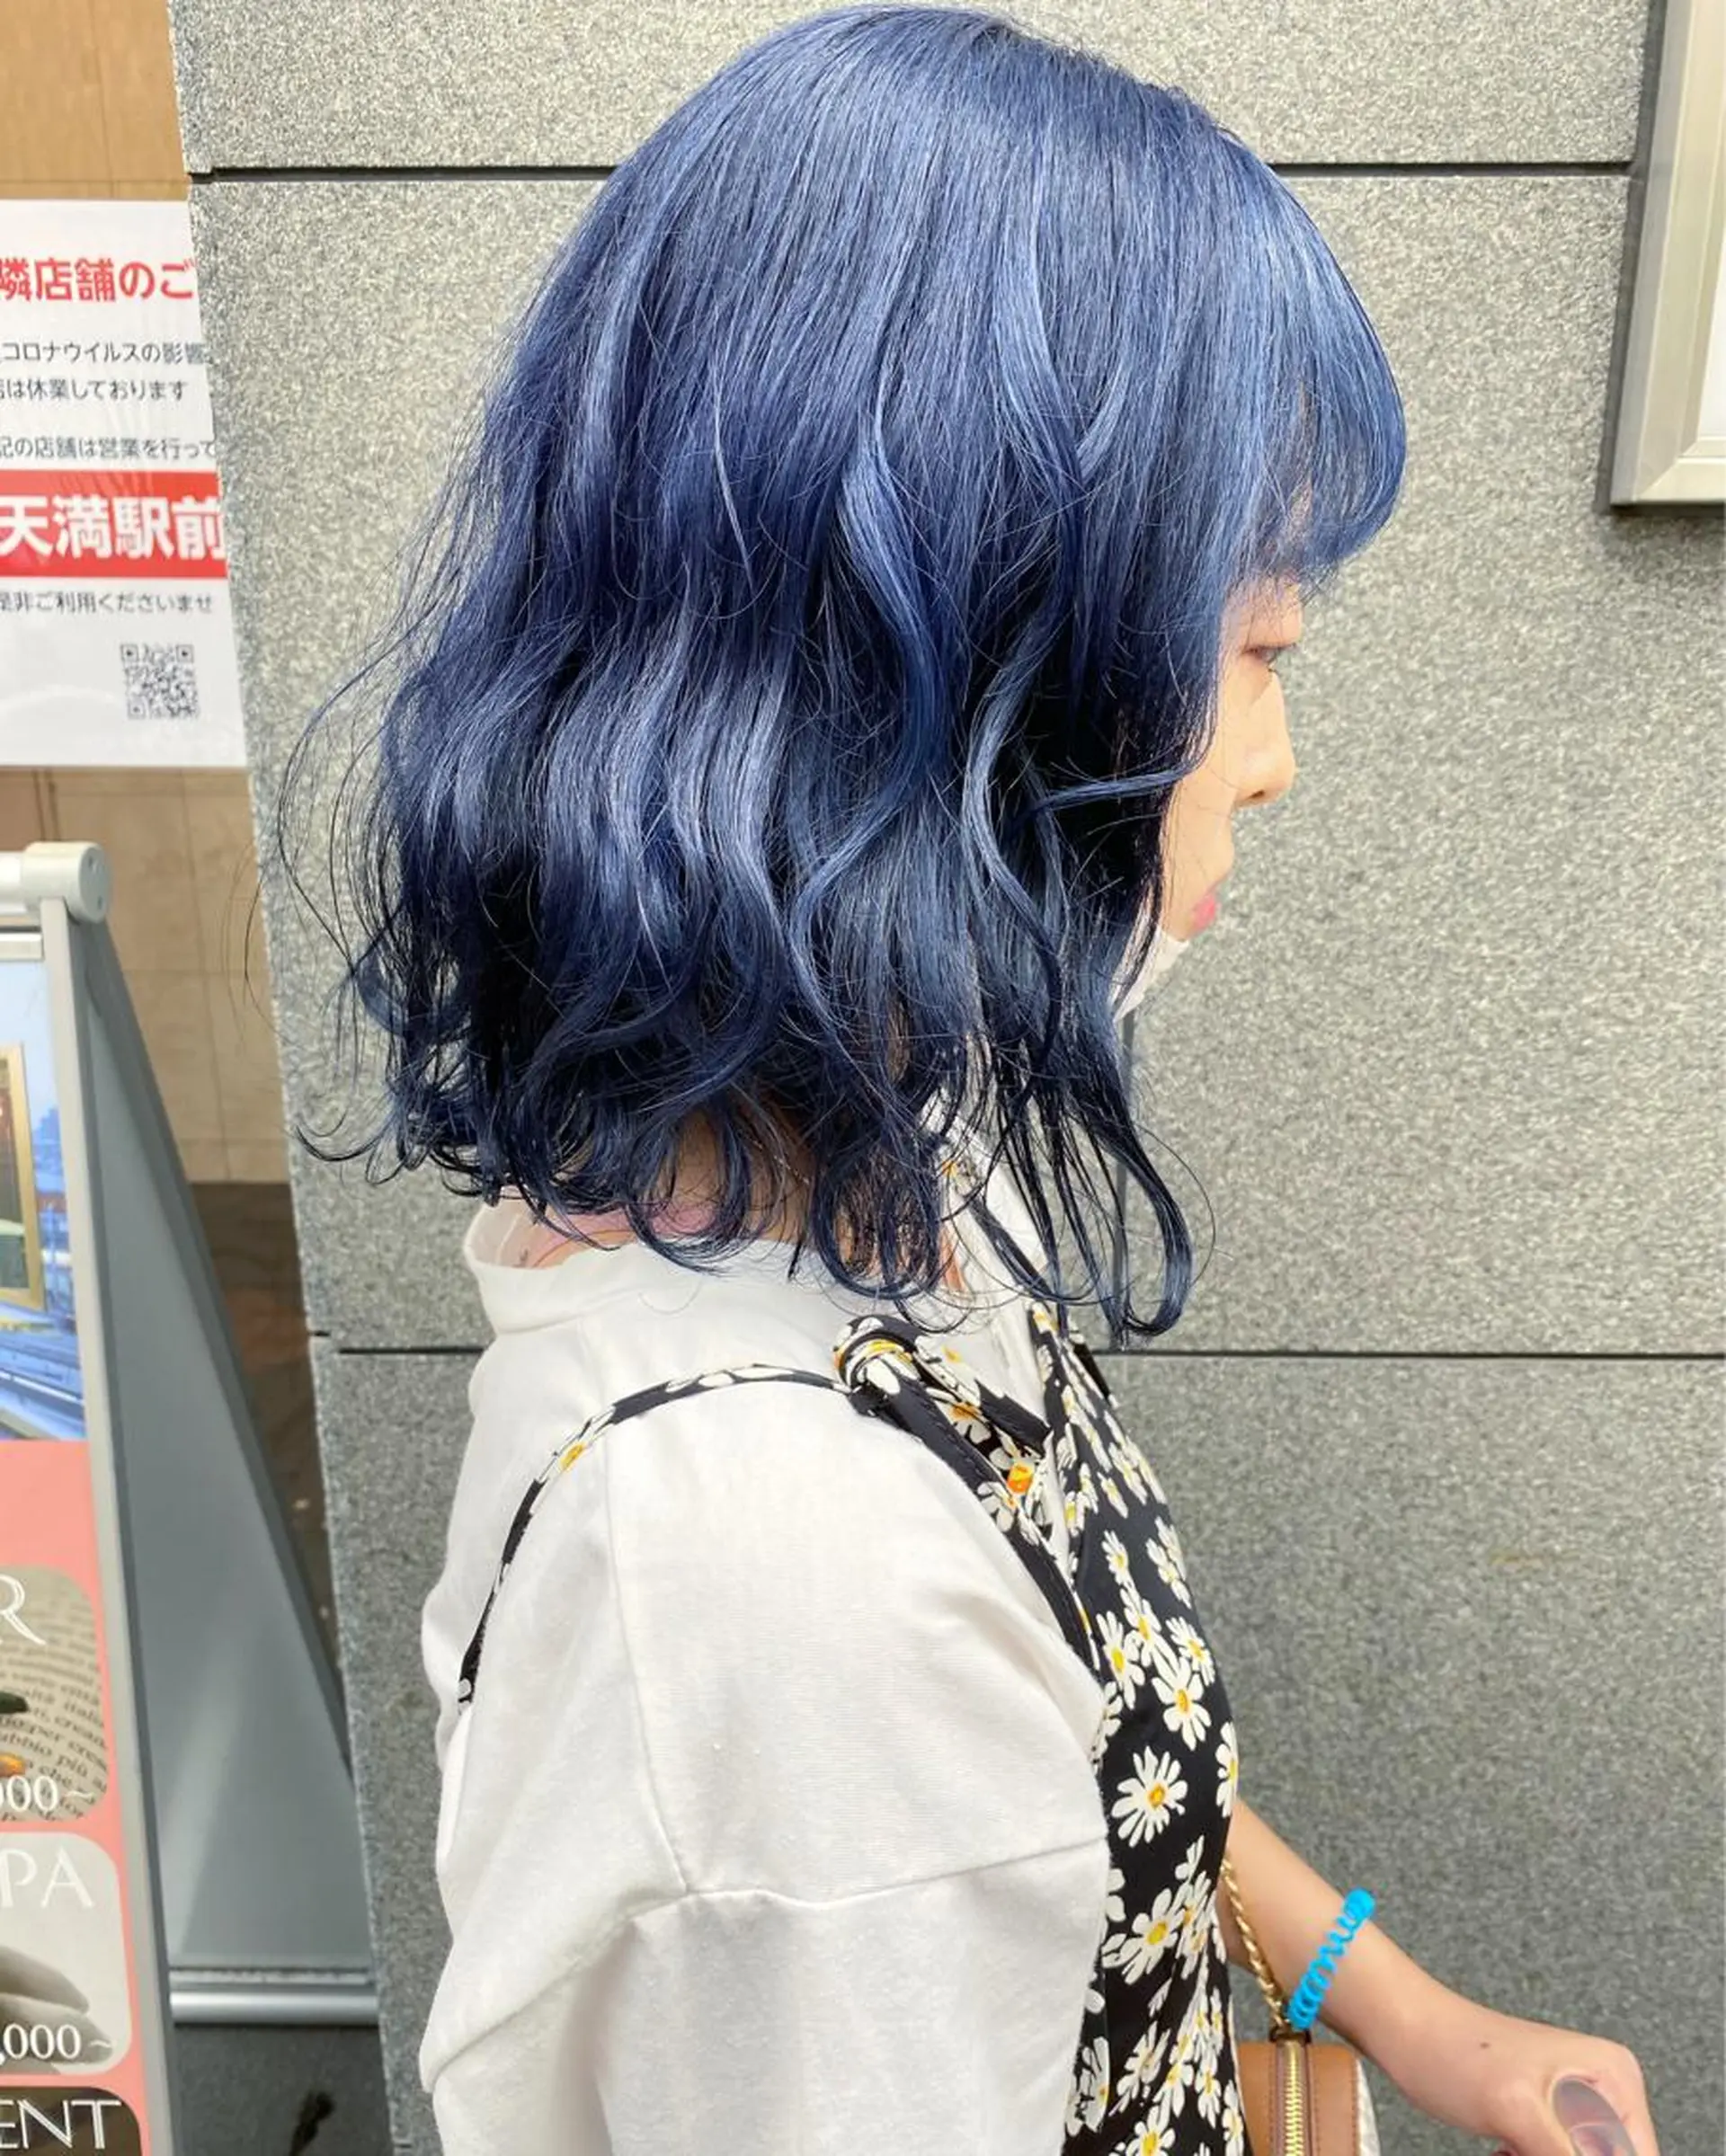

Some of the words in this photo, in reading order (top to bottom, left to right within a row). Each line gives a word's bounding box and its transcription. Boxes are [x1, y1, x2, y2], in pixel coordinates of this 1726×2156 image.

[0, 494, 225, 560] 天満駅前
[0, 1847, 95, 1909] PA
[0, 2099, 122, 2150] ENT
